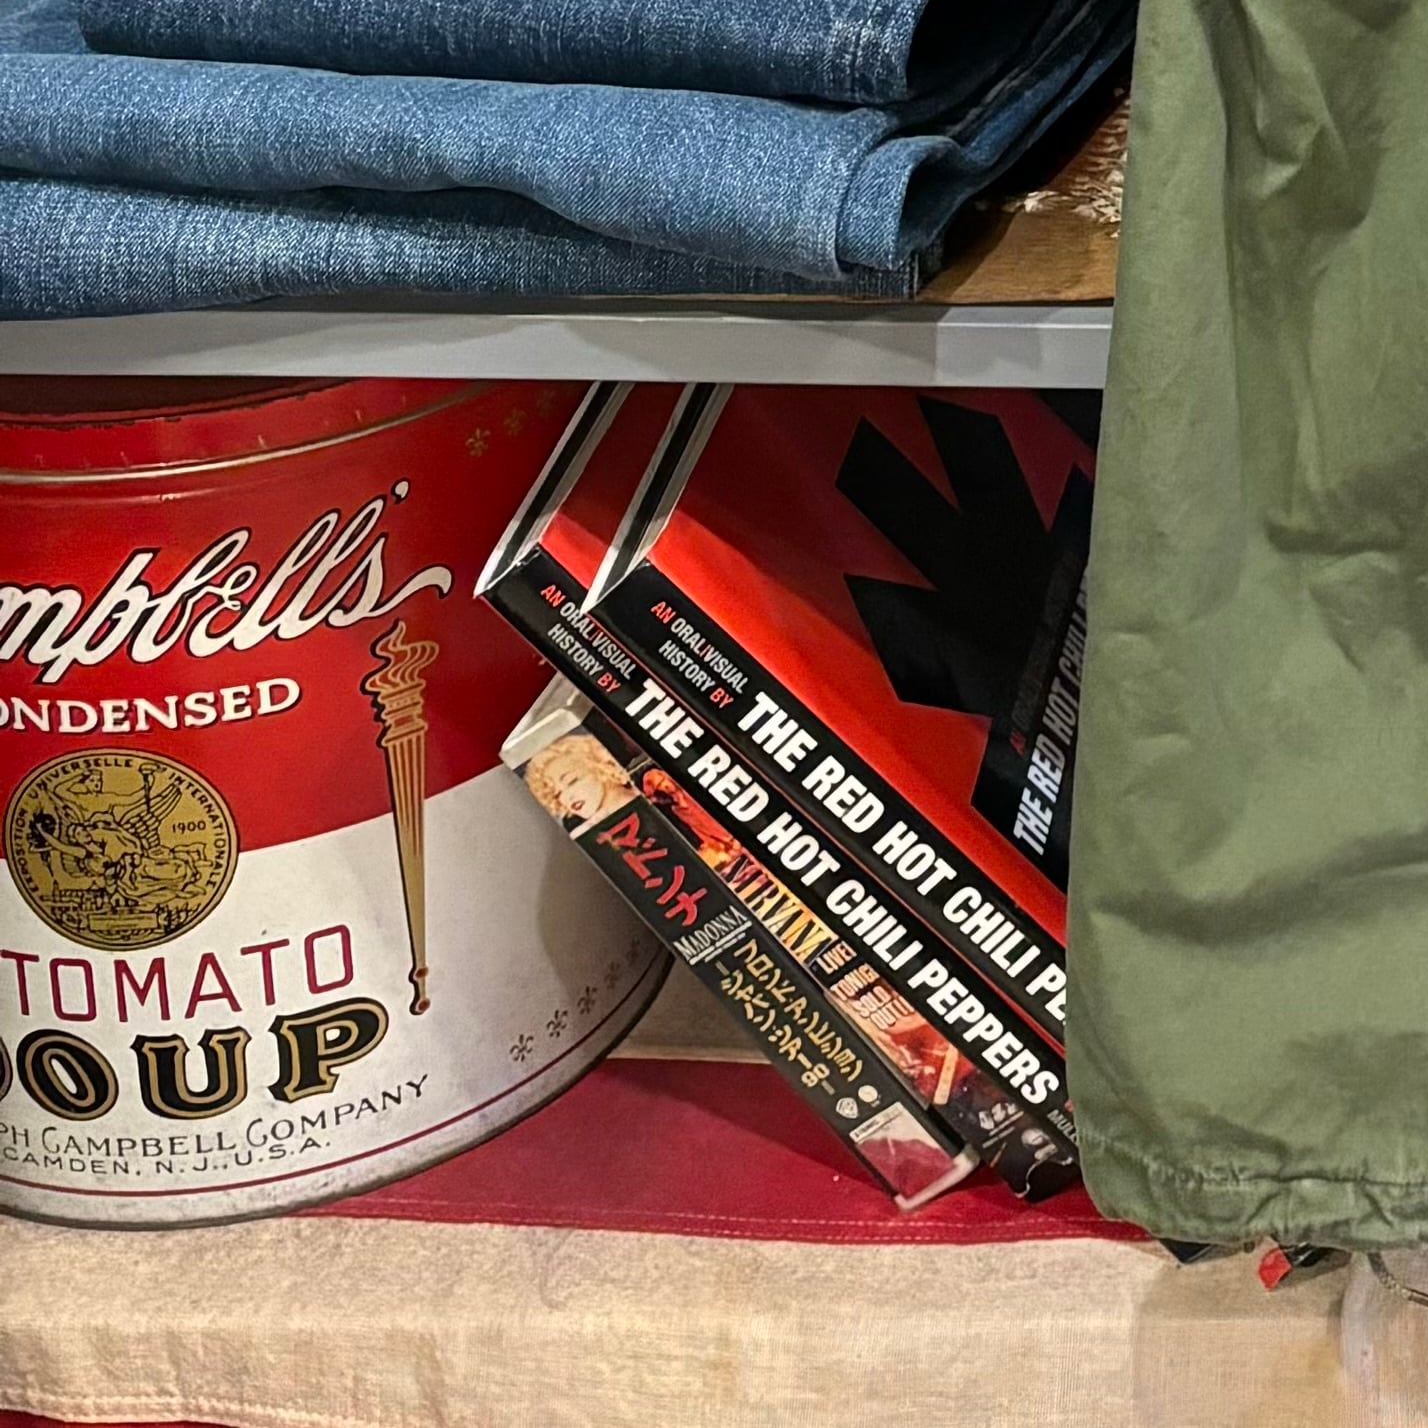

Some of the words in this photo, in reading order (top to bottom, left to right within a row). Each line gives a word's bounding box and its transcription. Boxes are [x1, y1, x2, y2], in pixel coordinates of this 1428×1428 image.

[540, 584, 565, 608] AN
[651, 601, 676, 624] AN
[547, 623, 603, 676] HISTORY
[596, 672, 621, 694] BY
[658, 639, 715, 692] HISTORY
[709, 687, 734, 709] BY
[1027, 733, 1066, 804] RED
[172, 820, 206, 835] 1900
[737, 692, 818, 772] THE
[801, 755, 885, 833] RED
[872, 820, 957, 896] HOT
[943, 886, 1041, 978] CHILI
[1013, 787, 1053, 856] THE
[596, 812, 708, 927] マドンナ
[625, 678, 704, 759] THE
[687, 744, 769, 822] RED
[756, 812, 841, 886] HOT
[826, 879, 923, 971] CHILI
[907, 958, 1059, 1104] PEPPERS
[673, 905, 748, 961] MADONNA
[717, 853, 835, 967] NIRVANA
[0, 924, 353, 1023] TOMATO
[0, 996, 390, 1121] OUP
